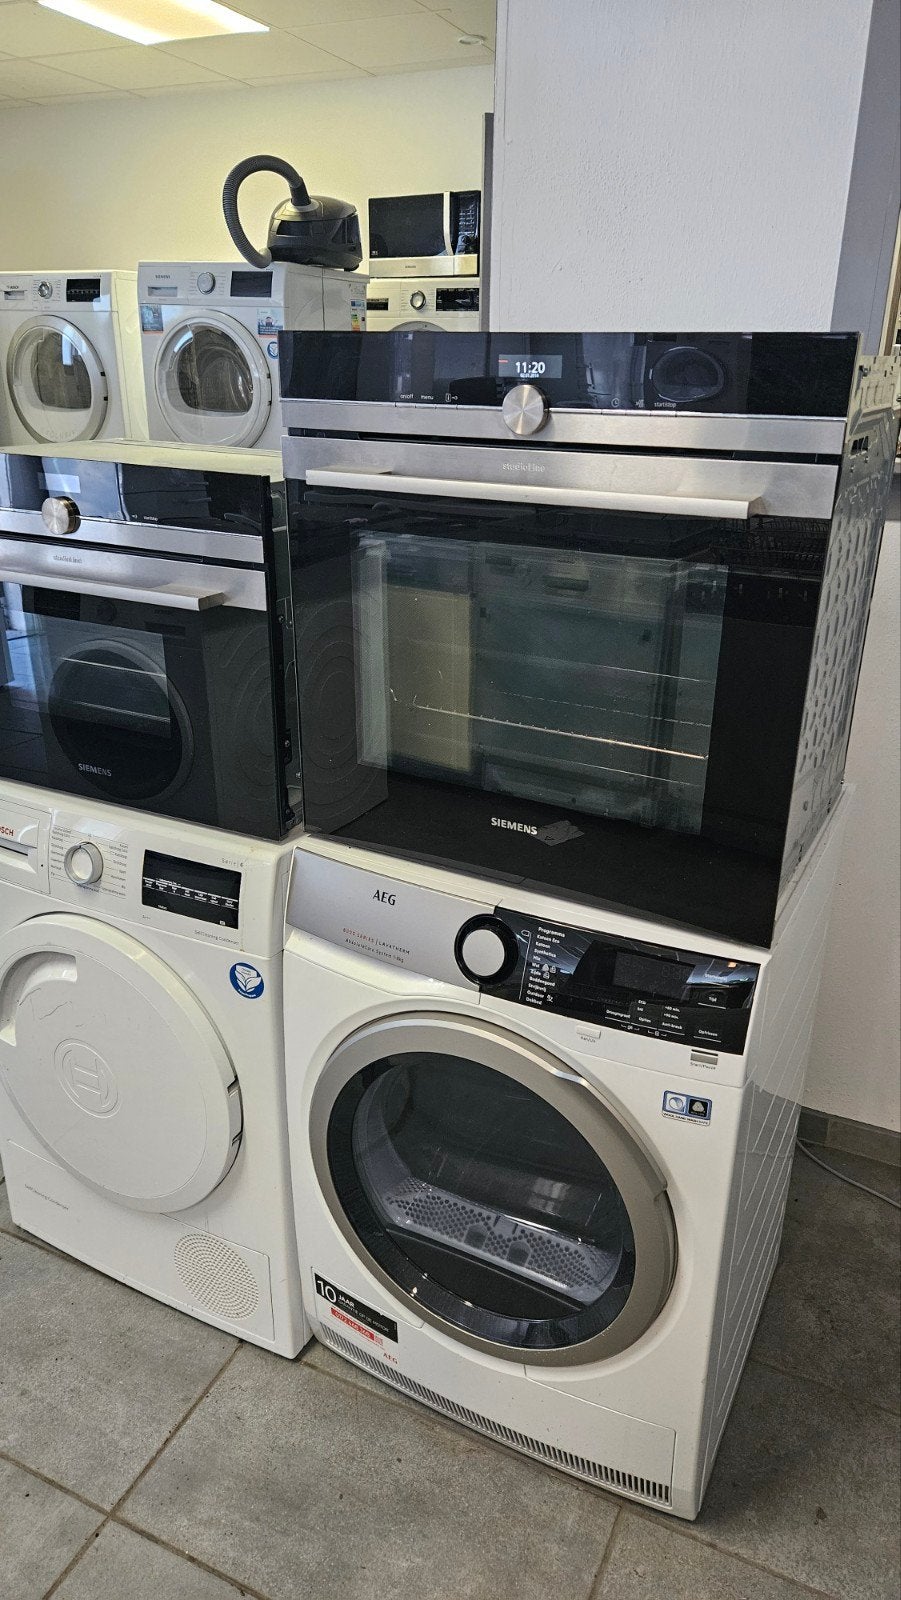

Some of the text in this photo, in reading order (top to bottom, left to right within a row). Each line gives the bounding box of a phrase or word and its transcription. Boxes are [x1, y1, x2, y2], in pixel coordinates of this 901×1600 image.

[515, 361, 546, 374] 11:20
[78, 763, 112, 777] SIEMENS
[0, 826, 14, 836] SCH
[490, 817, 538, 835] SIEMENS
[372, 889, 397, 906] AEG
[317, 1281, 337, 1303] 10
[339, 1295, 355, 1308] JAAR
